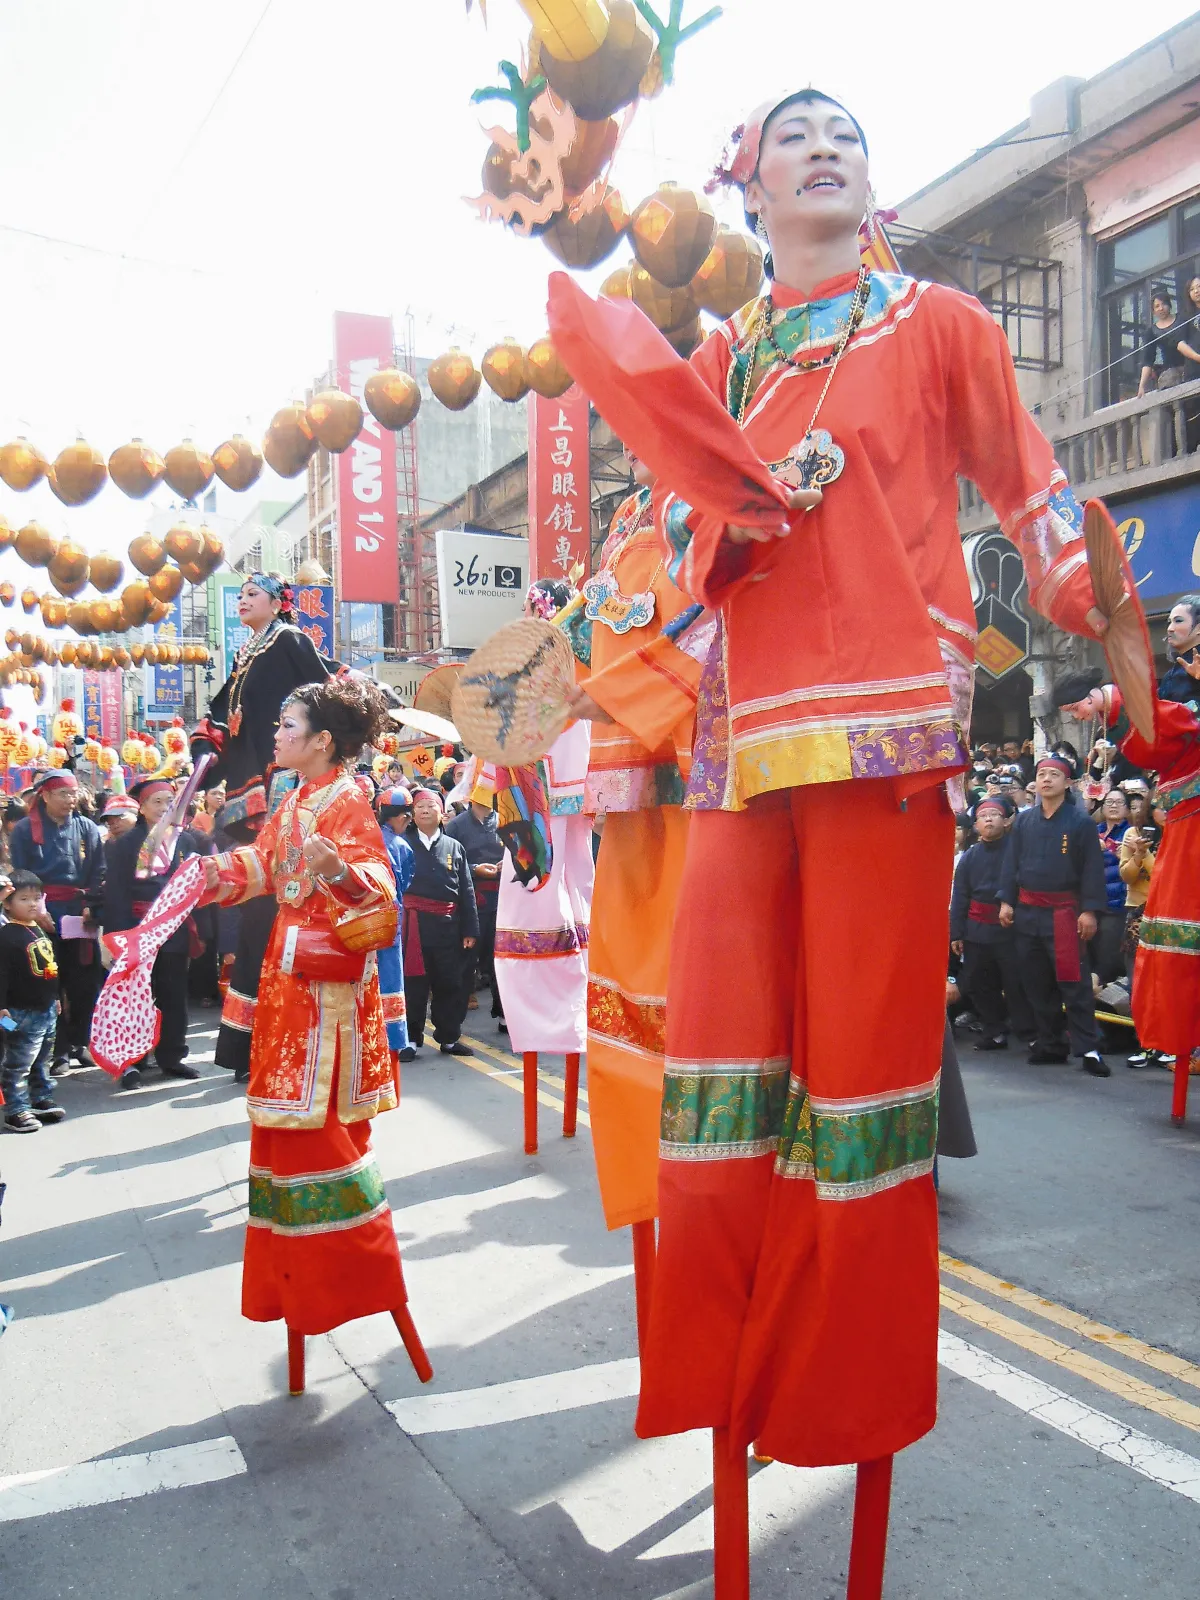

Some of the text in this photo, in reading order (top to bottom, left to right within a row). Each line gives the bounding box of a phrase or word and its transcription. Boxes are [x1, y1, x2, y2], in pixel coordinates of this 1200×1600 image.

[352, 441, 382, 504] AND
[355, 512, 386, 552] 1/2
[477, 590, 516, 598] PRODUCTS
